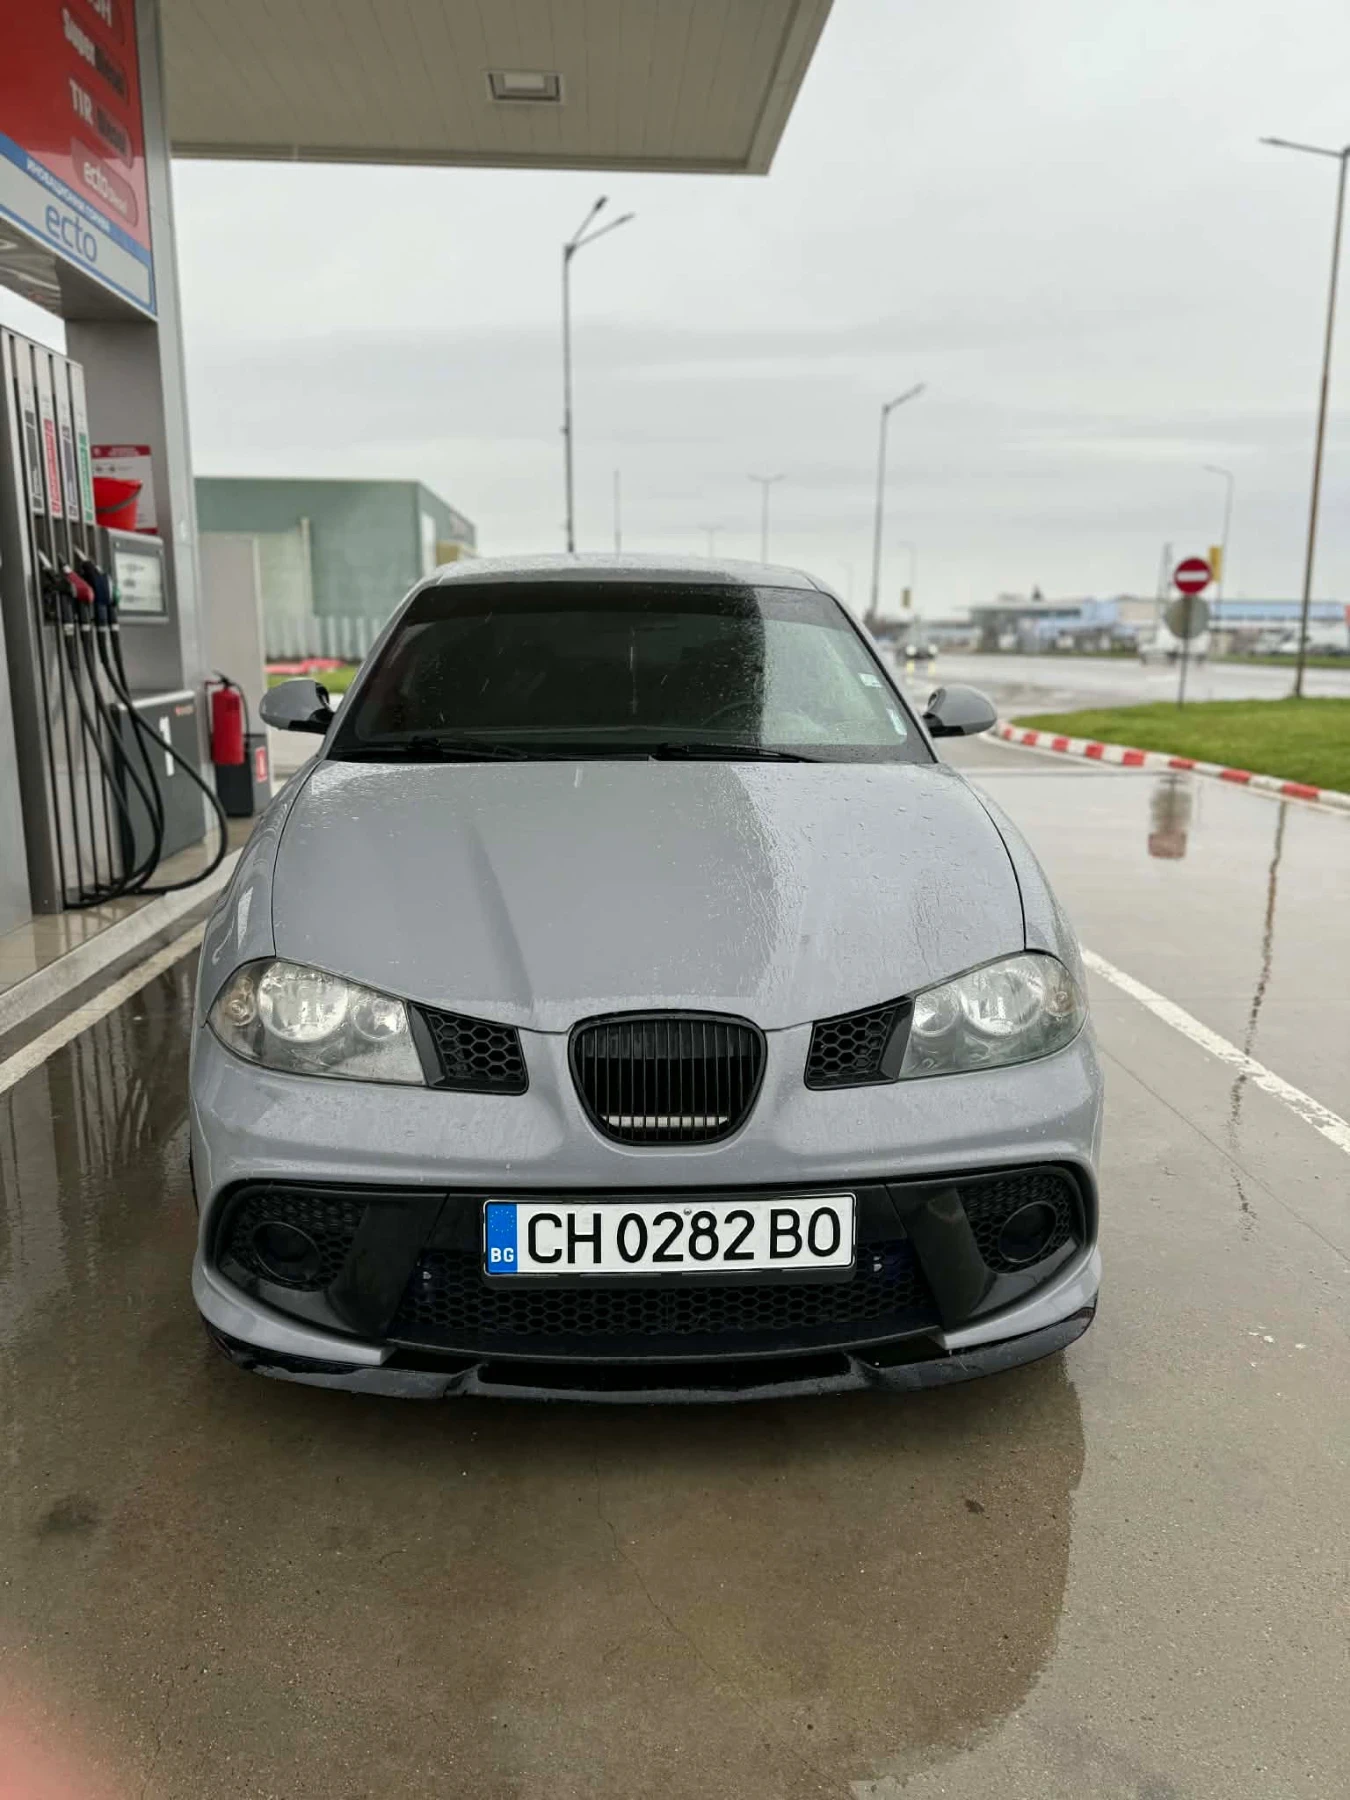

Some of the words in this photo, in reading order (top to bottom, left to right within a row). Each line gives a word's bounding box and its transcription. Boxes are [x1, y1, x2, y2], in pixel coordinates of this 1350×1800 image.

[45, 204, 98, 264] ecto
[490, 1247, 514, 1263] BG
[527, 1212, 602, 1264] CH
[616, 1209, 756, 1264] 0282
[769, 1206, 842, 1260] BO
